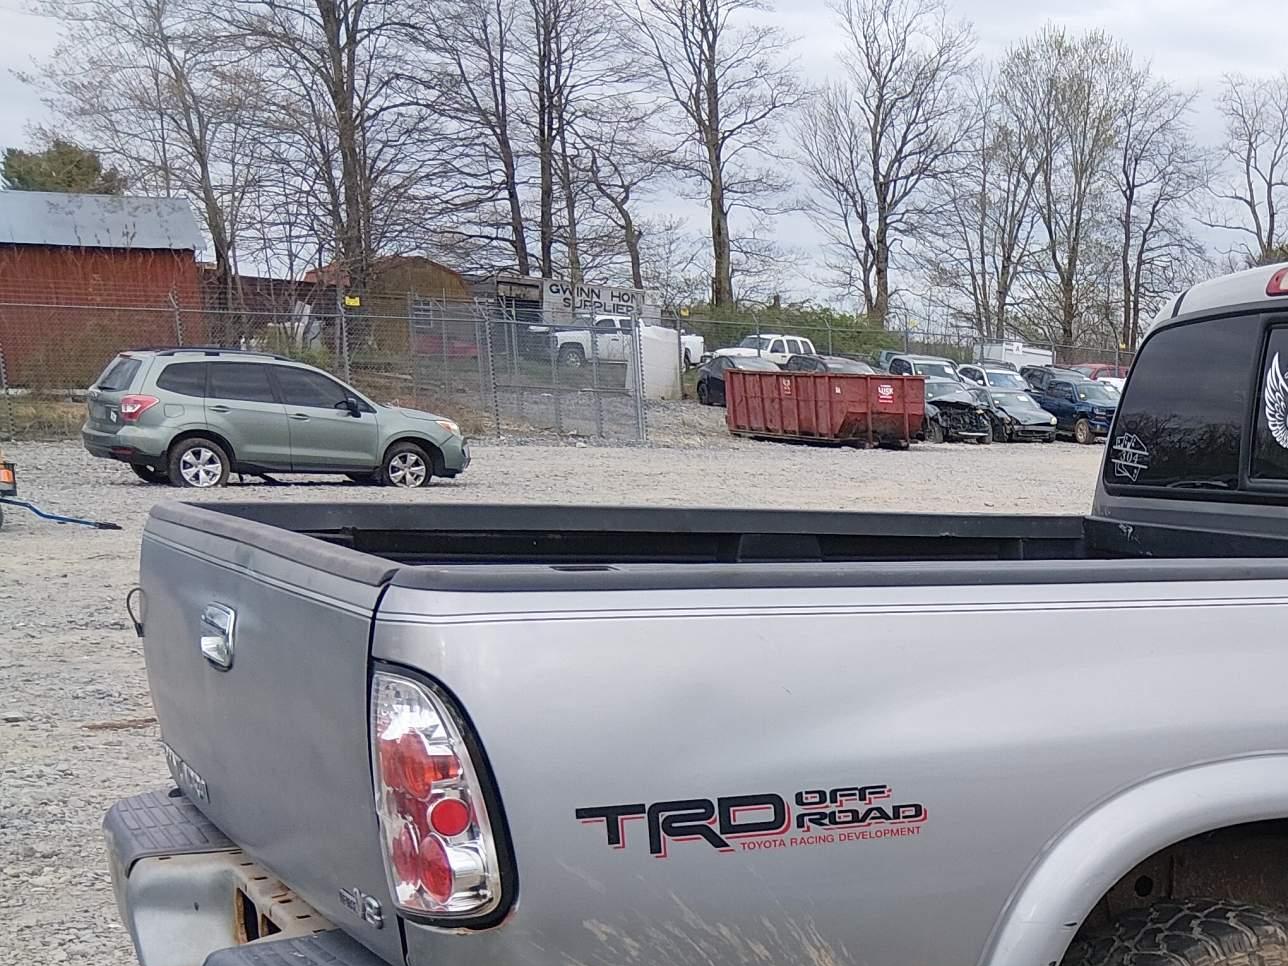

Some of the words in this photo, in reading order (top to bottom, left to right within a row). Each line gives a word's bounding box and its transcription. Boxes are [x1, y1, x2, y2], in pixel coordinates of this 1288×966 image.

[549, 284, 601, 300] GWINN
[1120, 450, 1139, 465] 304
[794, 784, 893, 808] OFF
[575, 793, 791, 859] TRD
[796, 803, 928, 833] ROAD
[740, 838, 787, 851] TOYOTA
[790, 833, 835, 848] RACING
[838, 826, 922, 843] DEVELOPMENT
